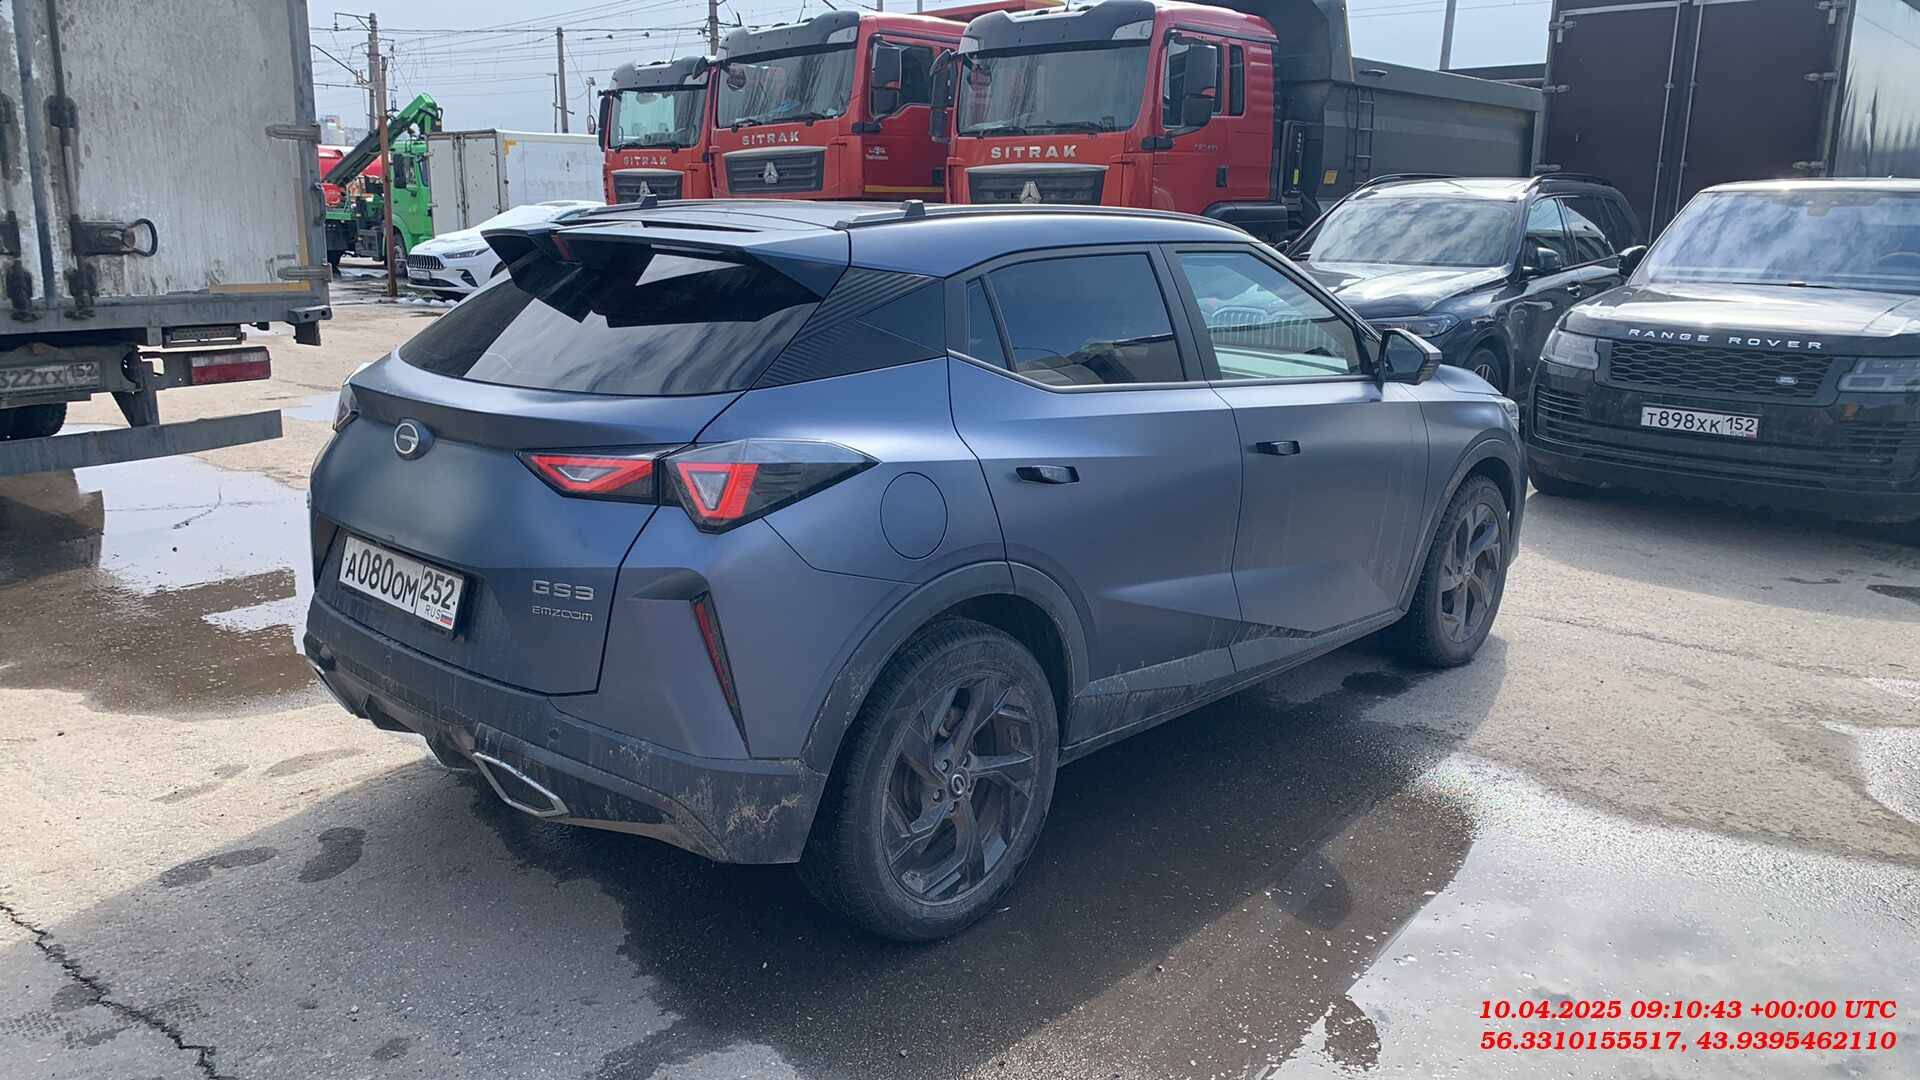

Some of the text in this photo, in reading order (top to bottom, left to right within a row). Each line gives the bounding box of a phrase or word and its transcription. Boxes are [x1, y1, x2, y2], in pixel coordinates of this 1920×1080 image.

[742, 131, 800, 145] SITRAK
[990, 144, 1078, 159] SITRAK
[623, 155, 667, 166] SITRAK
[1628, 328, 1823, 349] RANGE ROVER
[1725, 416, 1755, 432] 152
[420, 570, 455, 610] 252
[531, 579, 594, 601] GS3
[425, 604, 441, 620] RUS
